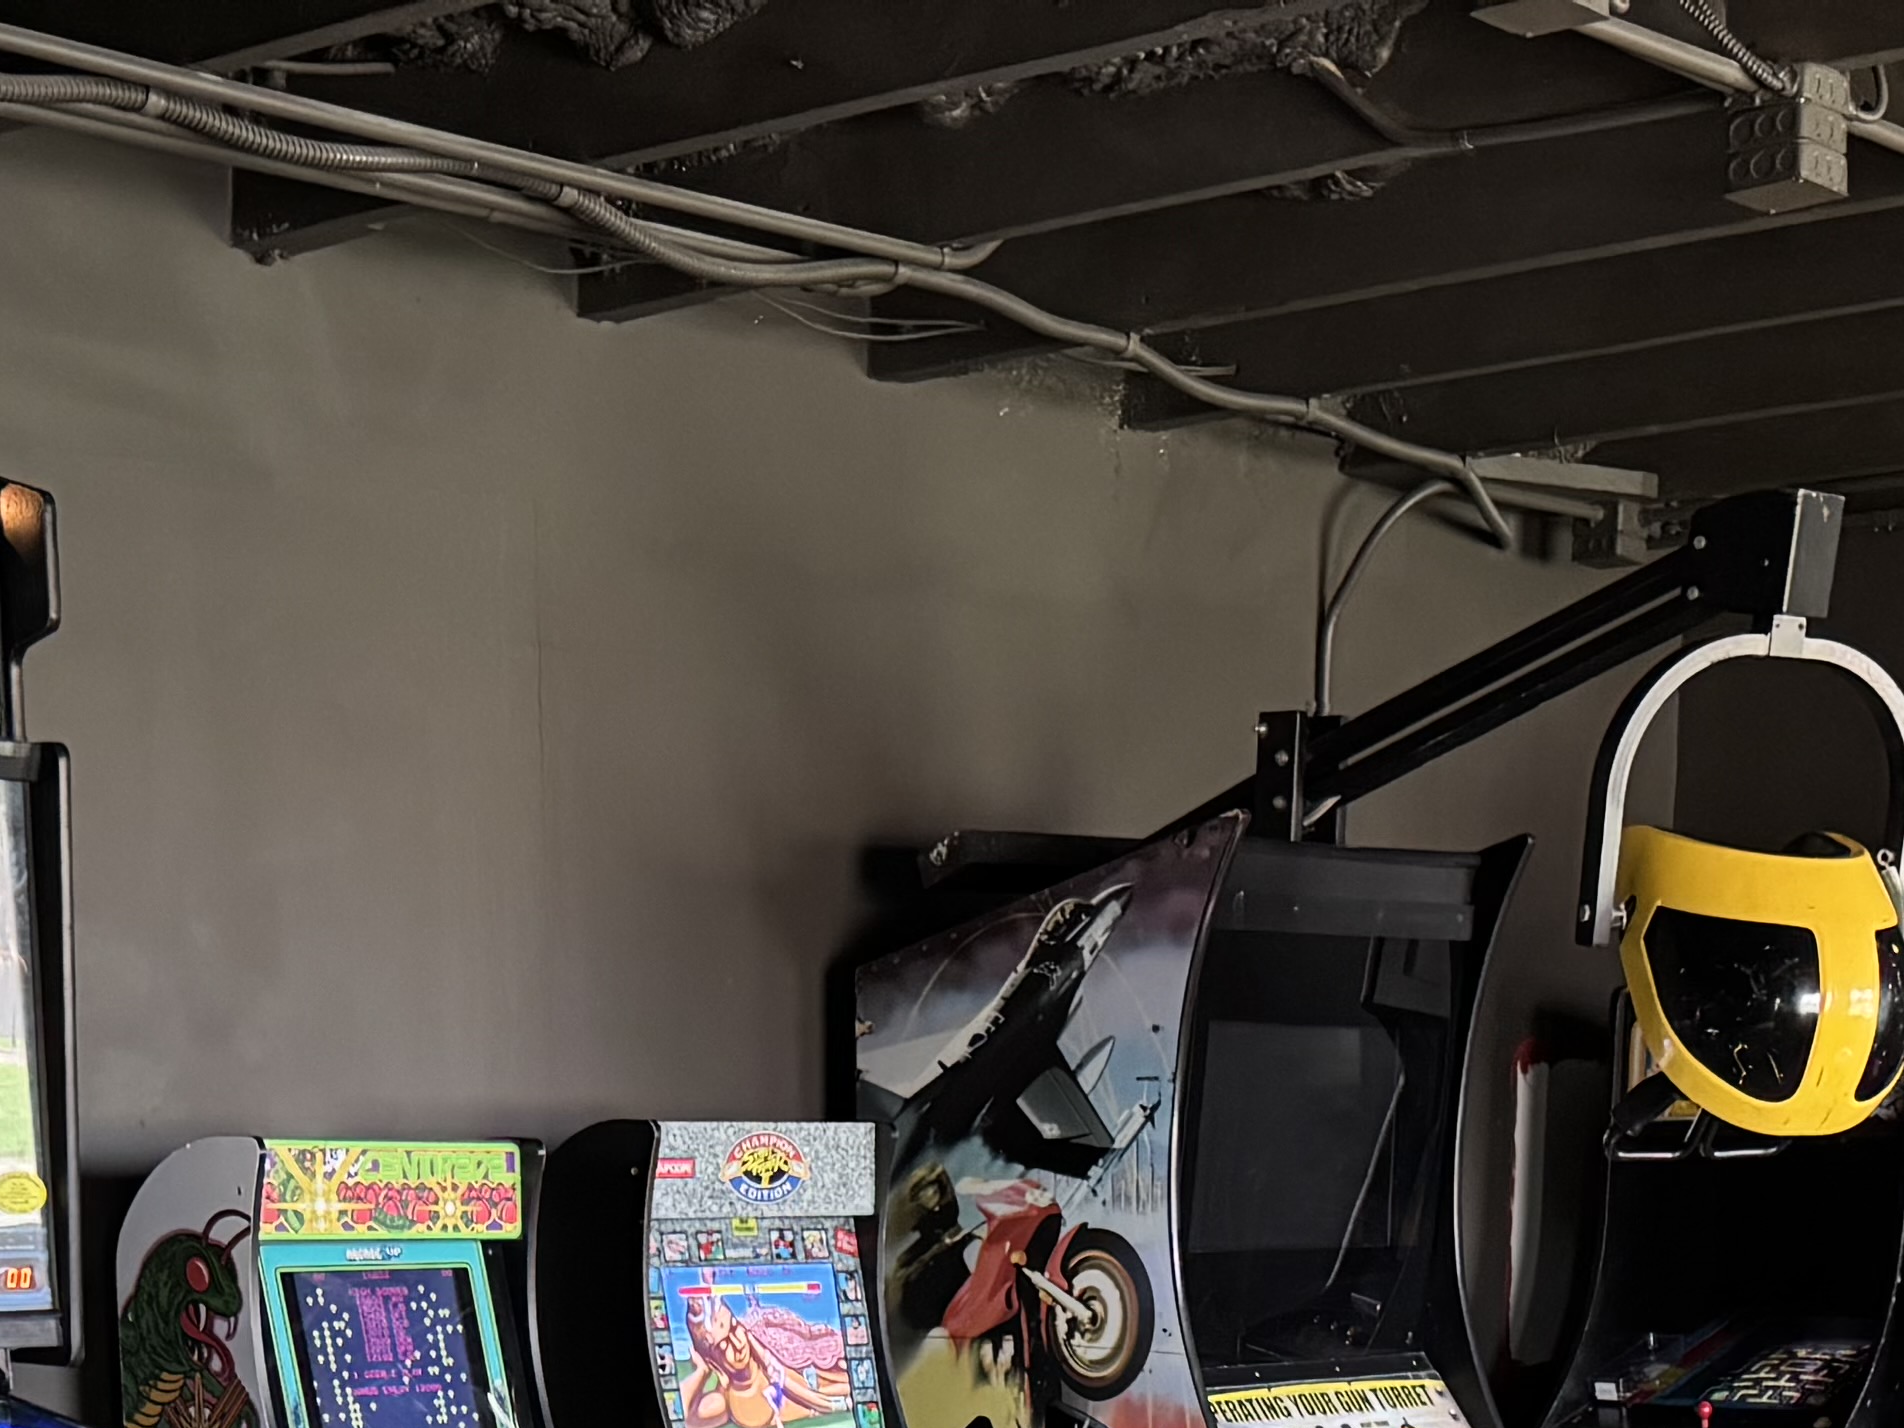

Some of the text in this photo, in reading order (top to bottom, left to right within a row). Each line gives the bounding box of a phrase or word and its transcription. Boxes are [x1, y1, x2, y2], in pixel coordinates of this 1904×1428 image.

[733, 1134, 796, 1159] CHAMPION
[358, 1150, 520, 1183] CENTIPEDE
[657, 1161, 693, 1175] APCOM
[739, 1182, 793, 1201] EDITION
[5, 1267, 33, 1290] 00
[1208, 1384, 1435, 1424] PERATING YOUR GUN TURRET
